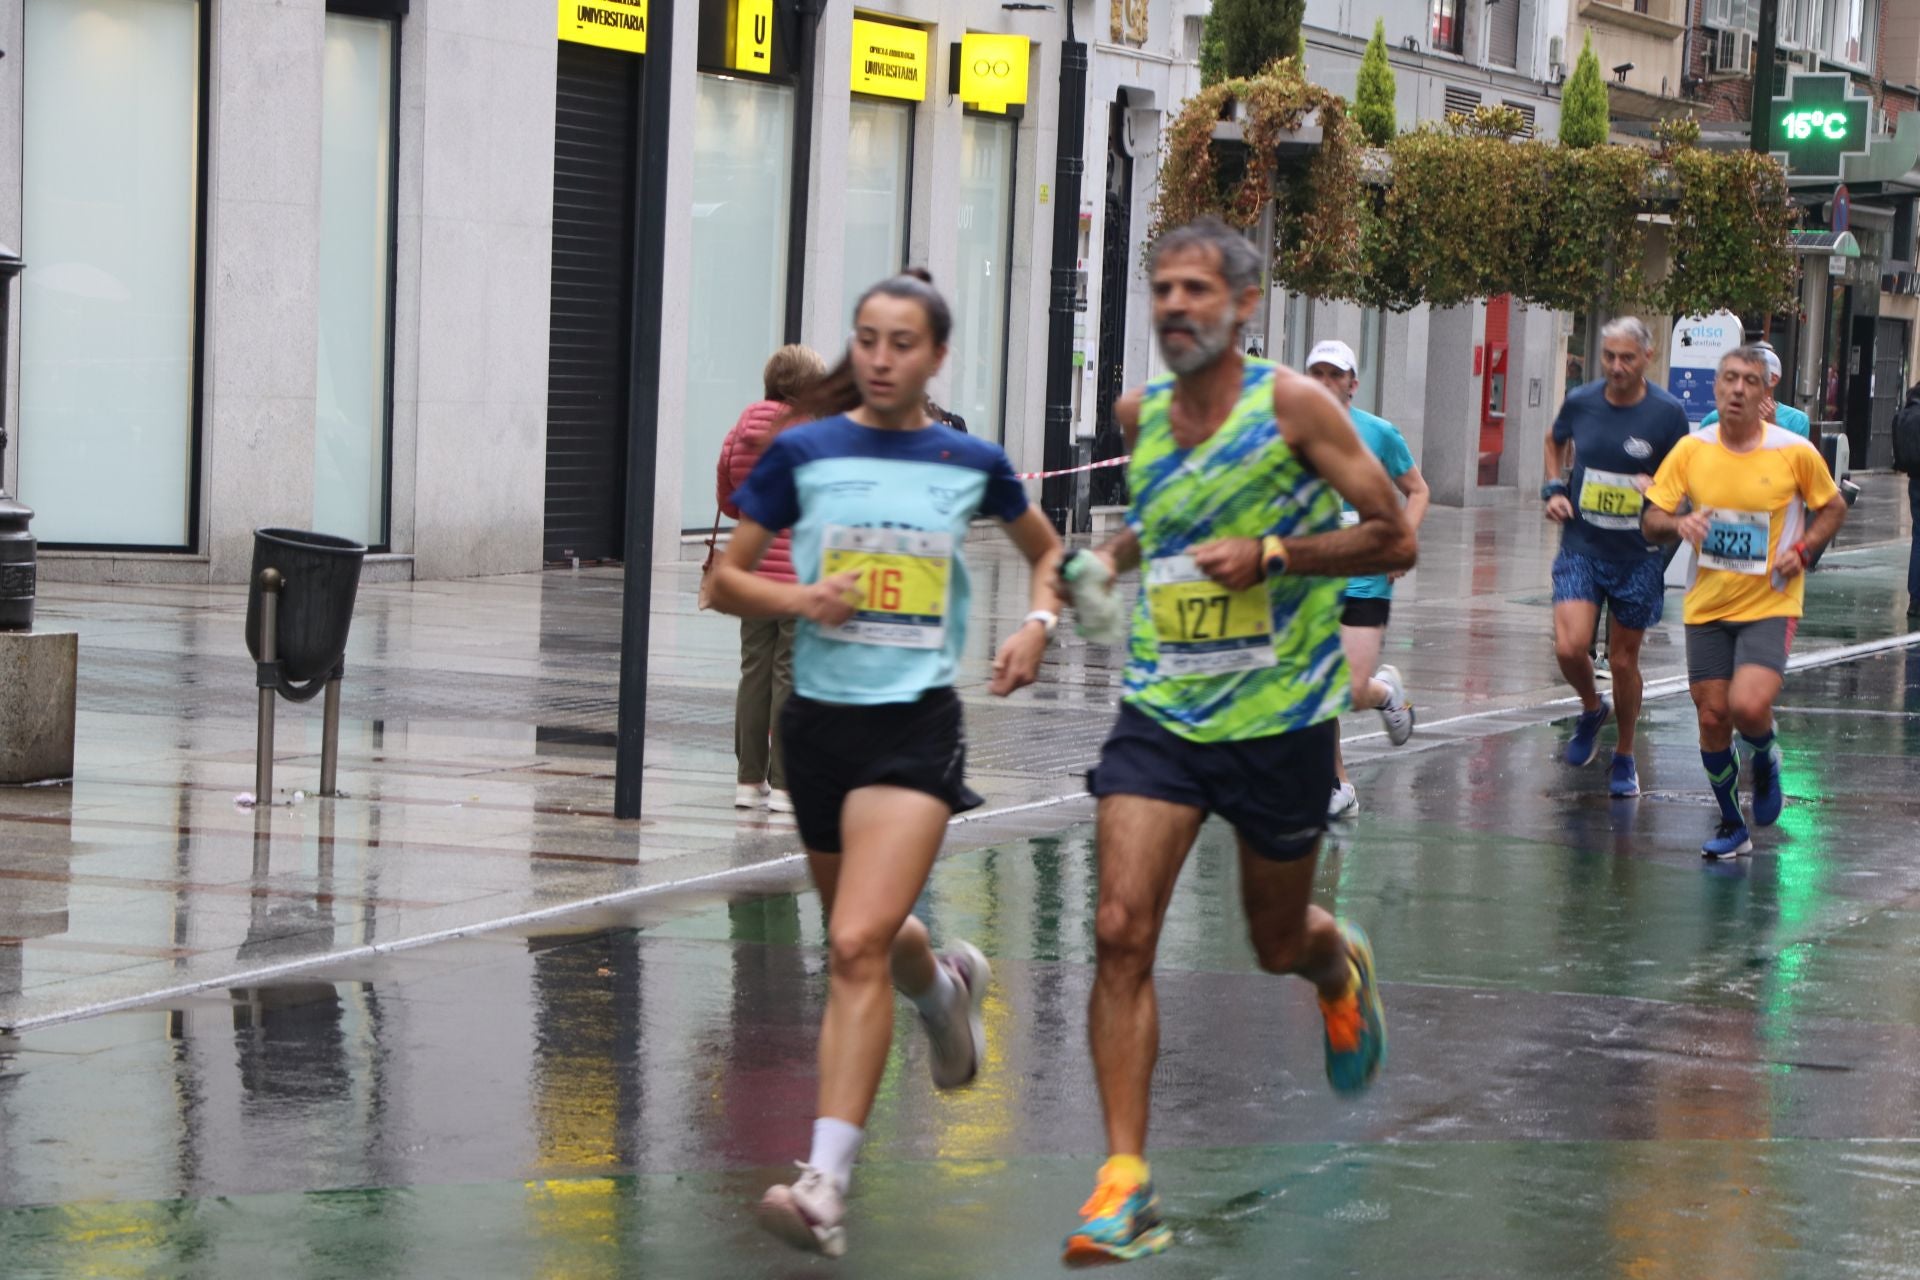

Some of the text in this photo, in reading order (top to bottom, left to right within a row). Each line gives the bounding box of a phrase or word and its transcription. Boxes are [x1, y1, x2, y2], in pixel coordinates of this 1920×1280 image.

[577, 5, 645, 32] UNIVERSITARIA
[755, 14, 766, 45] U
[864, 60, 918, 82] UNIVERSITARIA
[1691, 325, 1723, 338] alsa
[1598, 489, 1625, 514] 167
[1714, 528, 1752, 554] 323
[869, 567, 903, 611] 16
[1177, 595, 1230, 639] 127
